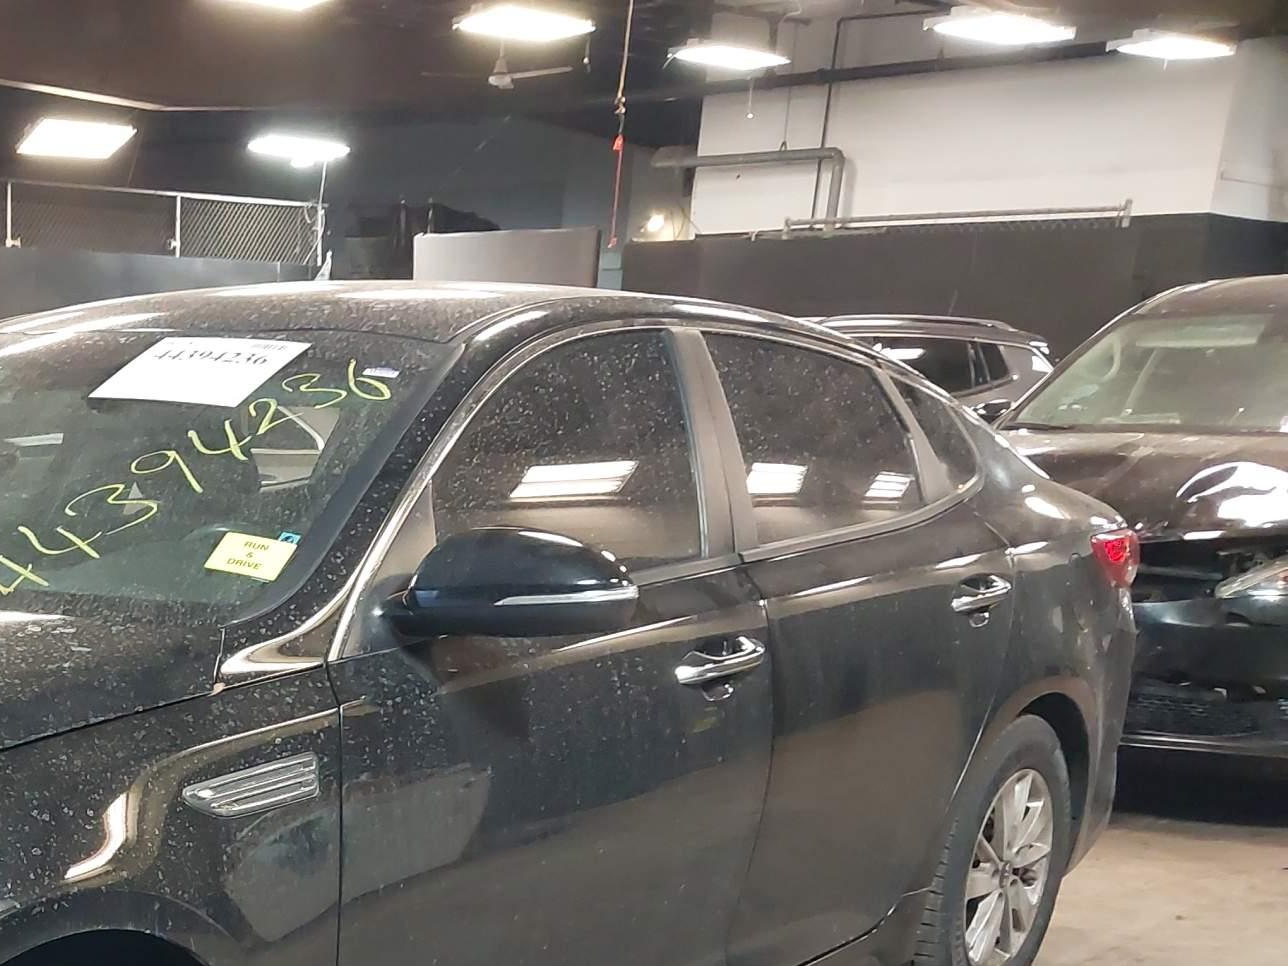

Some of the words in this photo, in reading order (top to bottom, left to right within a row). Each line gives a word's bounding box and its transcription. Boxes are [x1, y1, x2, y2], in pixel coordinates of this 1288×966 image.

[154, 350, 268, 365] 44394236
[244, 541, 269, 550] RUN
[227, 558, 262, 569] DRIVE
